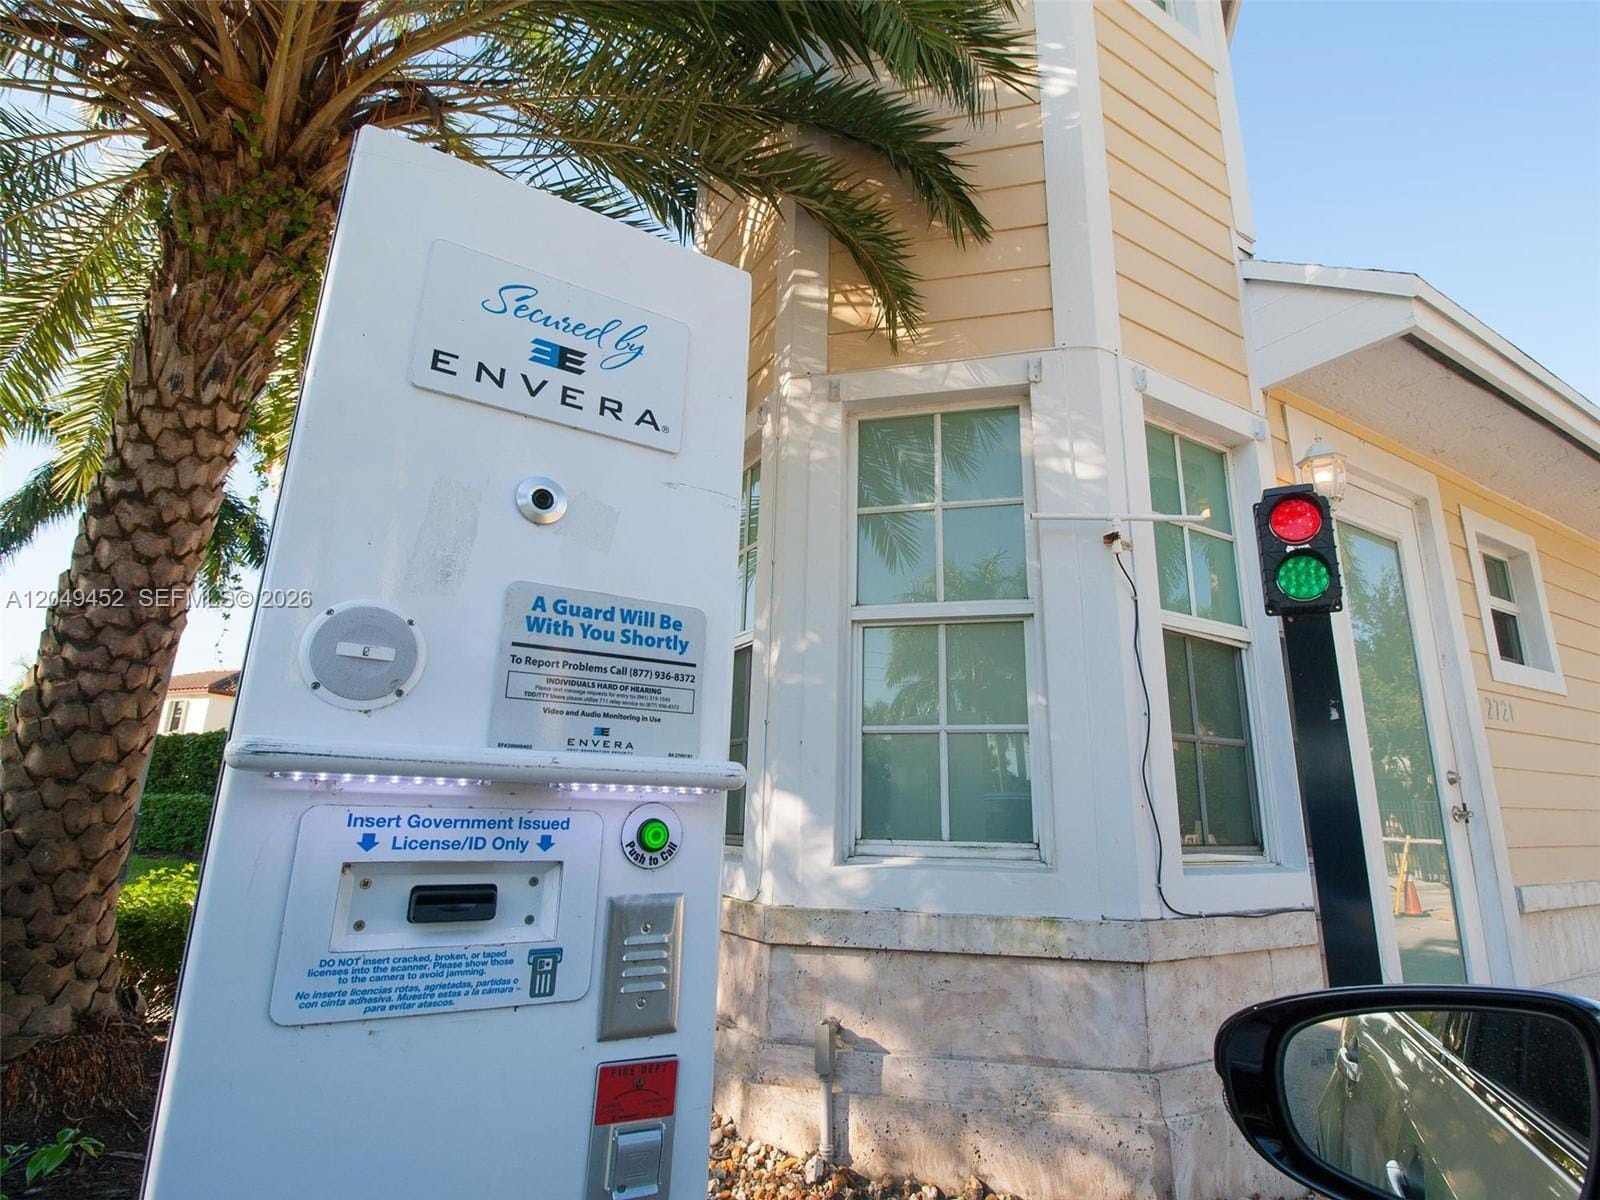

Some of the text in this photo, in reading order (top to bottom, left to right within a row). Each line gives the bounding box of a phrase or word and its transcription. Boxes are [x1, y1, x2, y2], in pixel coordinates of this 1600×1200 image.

[481, 284, 648, 370] Secured by
[531, 595, 683, 631] A Guard Will Be
[526, 615, 689, 655] With You Shortly
[510, 654, 696, 683] To Report Problems Call (877) 936-8372
[524, 690, 549, 699] TDD/TTY
[546, 677, 662, 695] INDIVIDUALS HARD OF HEARING
[543, 707, 564, 715] Video
[565, 709, 579, 717] and
[580, 710, 601, 718] Audio
[602, 711, 641, 722] Monitoring
[567, 738, 634, 750] ENVERA
[347, 812, 570, 831] Insert Government Issued
[392, 835, 530, 853] License/ID Only
[625, 840, 678, 866] Push to Call
[307, 958, 514, 977] licenses into the scanner. Please show those
[319, 959, 336, 968] DO
[338, 956, 361, 967] NOT
[363, 956, 390, 966] insert
[393, 954, 432, 964] cracked,
[435, 952, 469, 962] broken,
[483, 950, 507, 960] taped
[338, 968, 487, 984] to the camera to avoid jamming.
[295, 991, 310, 1000] No
[312, 990, 348, 999] inserte
[350, 985, 392, 996] licencias
[394, 983, 421, 993] rotas,
[424, 980, 473, 992] agrietadas,
[475, 978, 511, 988] partidas
[298, 1000, 318, 1009] con
[321, 998, 346, 1008] cinta
[348, 995, 394, 1006] adhesiva.
[397, 991, 435, 1002] Muestre
[437, 990, 462, 998] estas
[471, 988, 480, 996] la
[363, 999, 455, 1014] para evitar atascos.
[611, 1063, 668, 1079] FIRE DEPT
